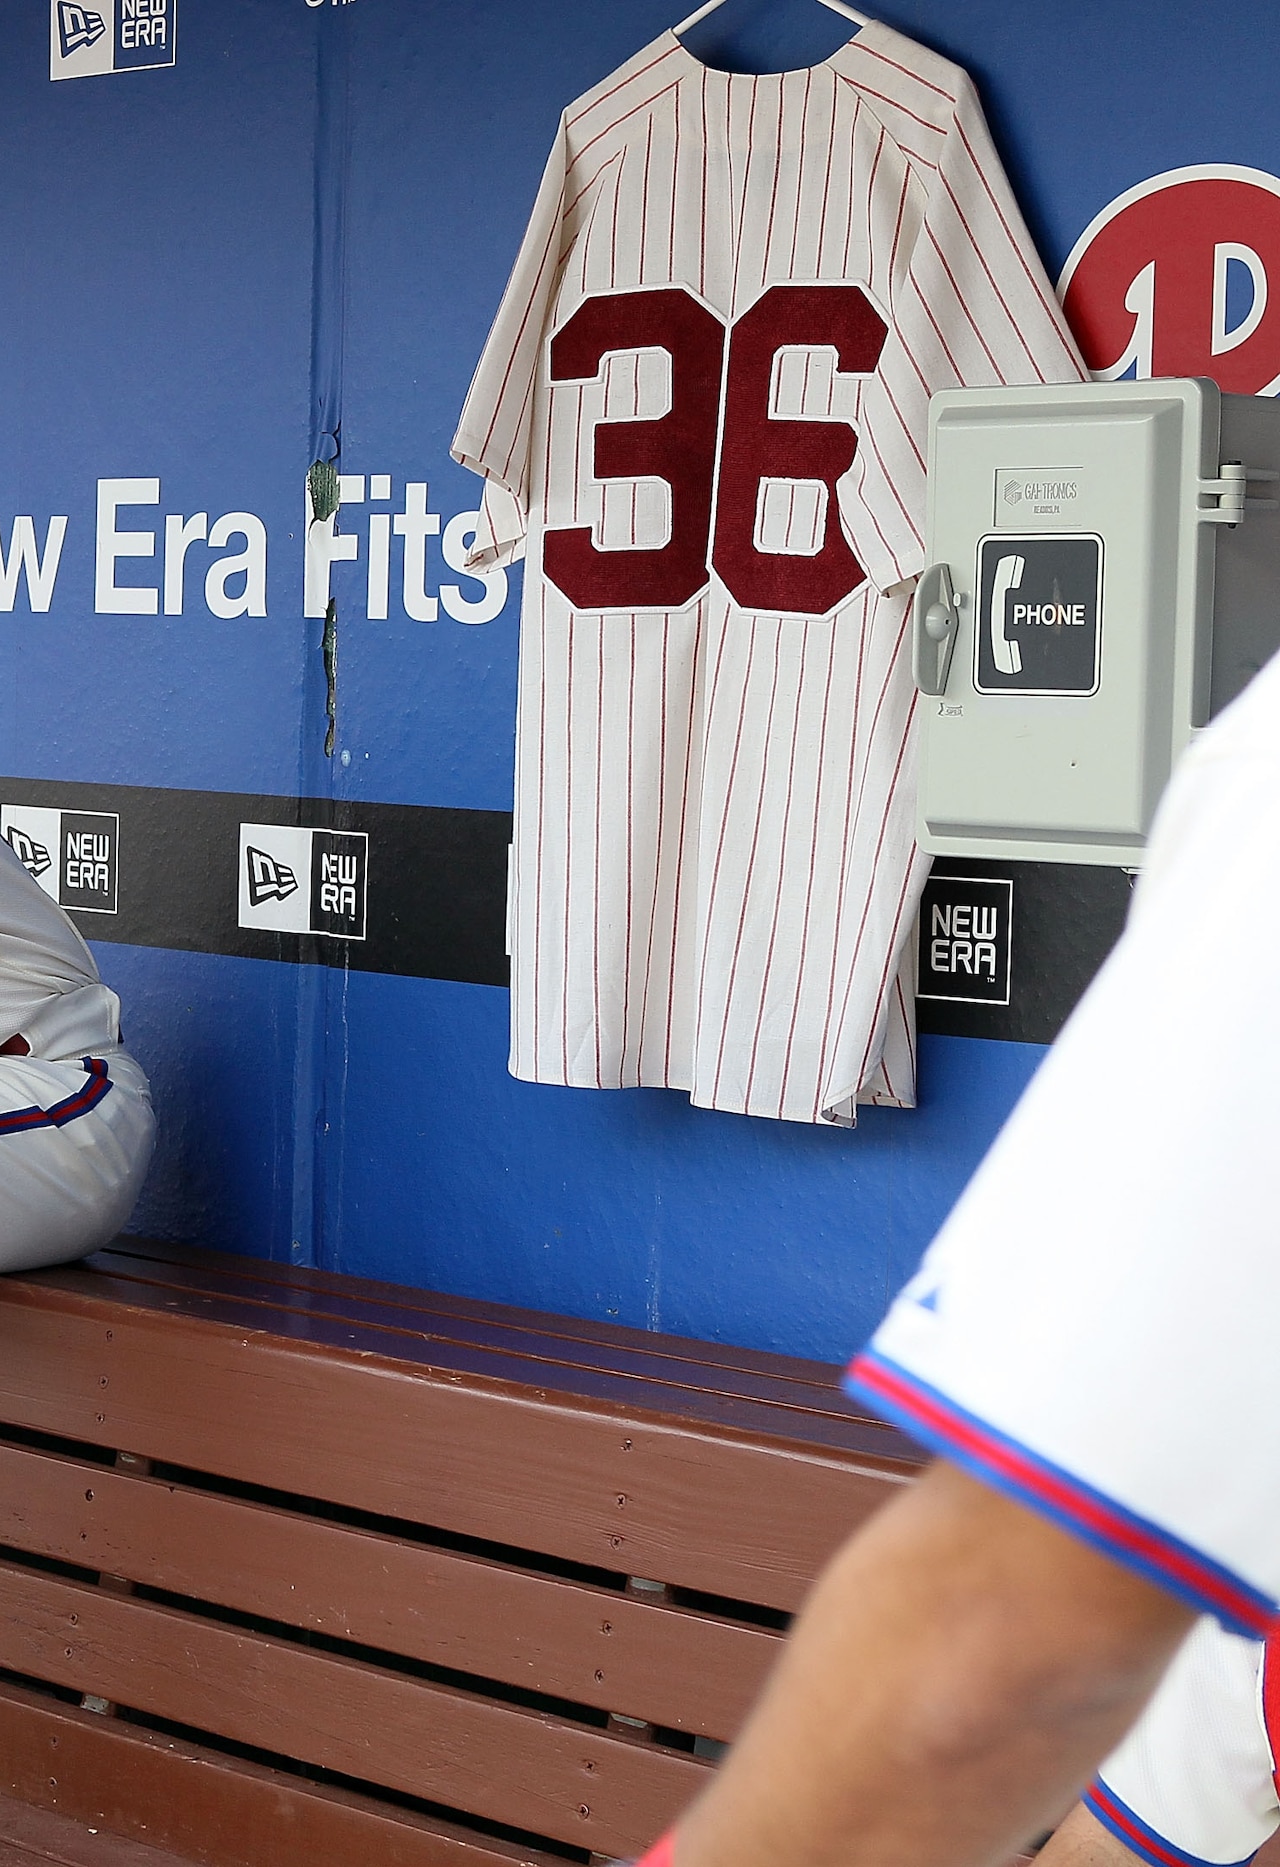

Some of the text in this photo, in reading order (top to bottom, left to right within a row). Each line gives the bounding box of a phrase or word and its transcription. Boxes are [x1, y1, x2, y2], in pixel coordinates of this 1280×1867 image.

[122, 17, 166, 49] ERA
[541, 278, 892, 622] 36
[94, 477, 267, 619] Era
[303, 474, 508, 625] Fits
[1013, 604, 1086, 626] PHONE
[67, 832, 110, 862] NEW
[67, 860, 109, 891] ERA
[321, 852, 357, 885] NEW
[931, 903, 997, 941] NEW
[931, 939, 996, 976] ERA
